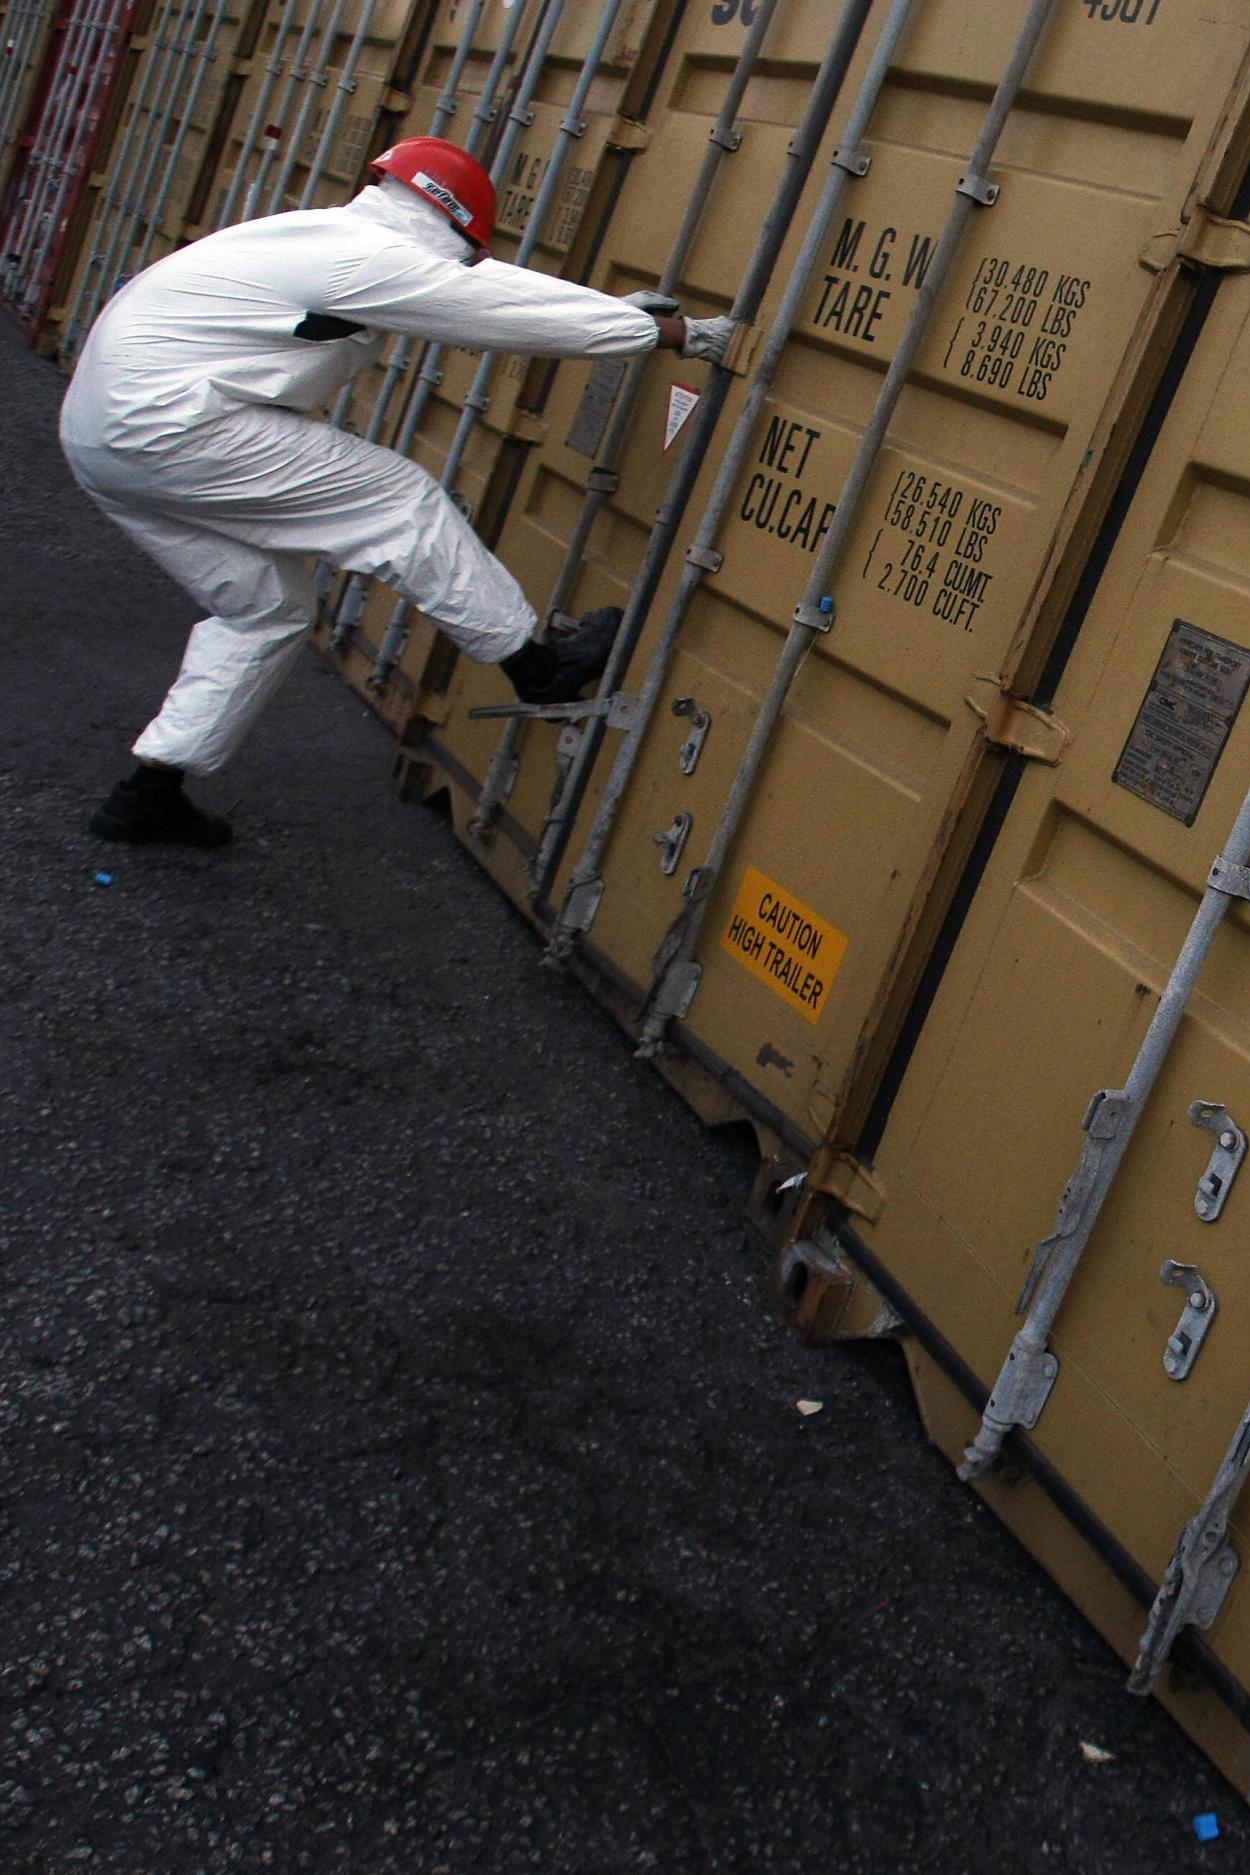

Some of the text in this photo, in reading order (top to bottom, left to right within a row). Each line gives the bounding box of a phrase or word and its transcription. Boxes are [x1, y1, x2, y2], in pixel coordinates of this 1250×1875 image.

[813, 275, 891, 342] TARE
[1041, 304, 1077, 338] LBS
[1052, 274, 1091, 309] KGS
[961, 349, 1052, 401] 8.690 LBS
[972, 321, 1067, 371] 3.940 KGS
[759, 415, 821, 478] NET
[891, 499, 988, 563] 58.510 LBS
[900, 472, 1002, 535] 26.540 KGS
[901, 539, 940, 579] 76.4
[878, 563, 980, 633] 2.700 CU.FT.
[758, 893, 823, 960] CAUTION
[728, 914, 824, 1009] HIGH TRAILER
